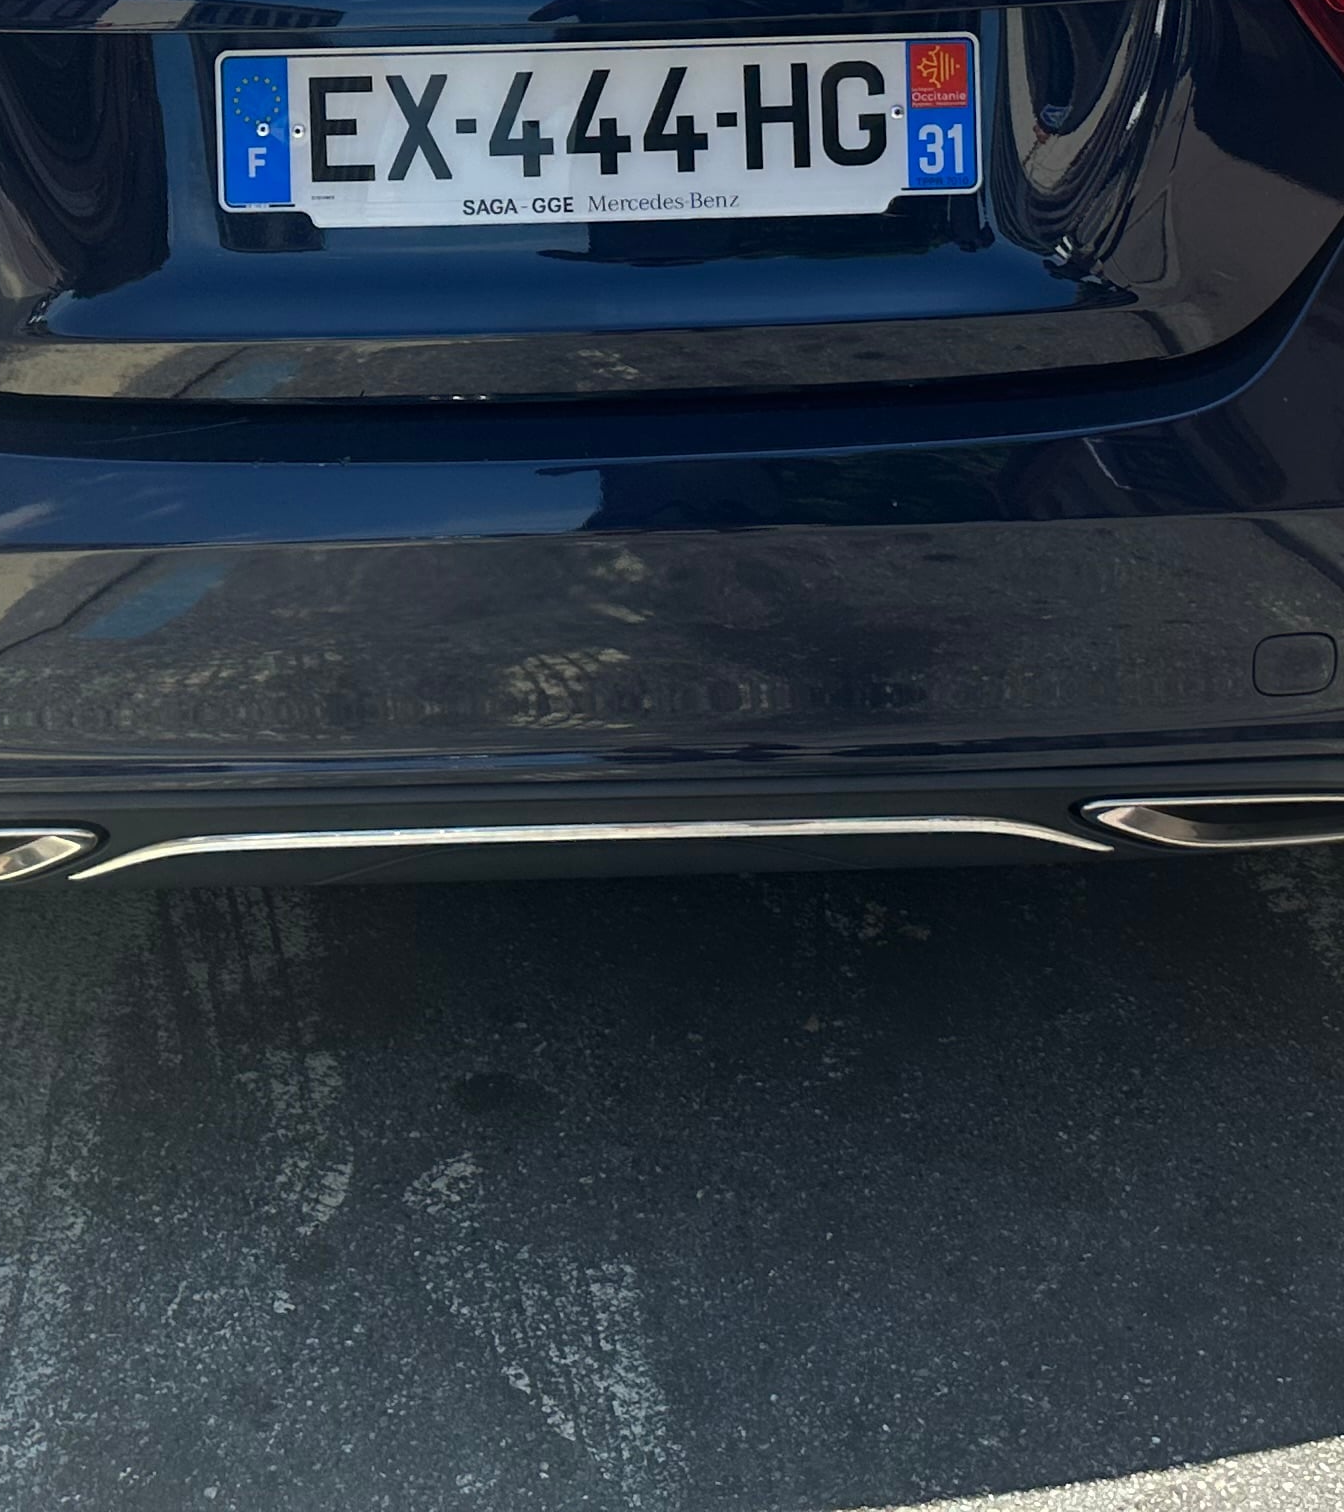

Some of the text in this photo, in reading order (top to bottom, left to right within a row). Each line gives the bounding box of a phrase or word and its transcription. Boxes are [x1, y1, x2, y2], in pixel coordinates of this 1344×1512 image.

[911, 90, 967, 103] Occitanie
[247, 61, 887, 182] F EX-444-HG
[918, 123, 964, 174] 31
[463, 199, 518, 215] SAGA
[532, 196, 574, 213] GGE
[587, 191, 740, 213] Mercedes-Benz
